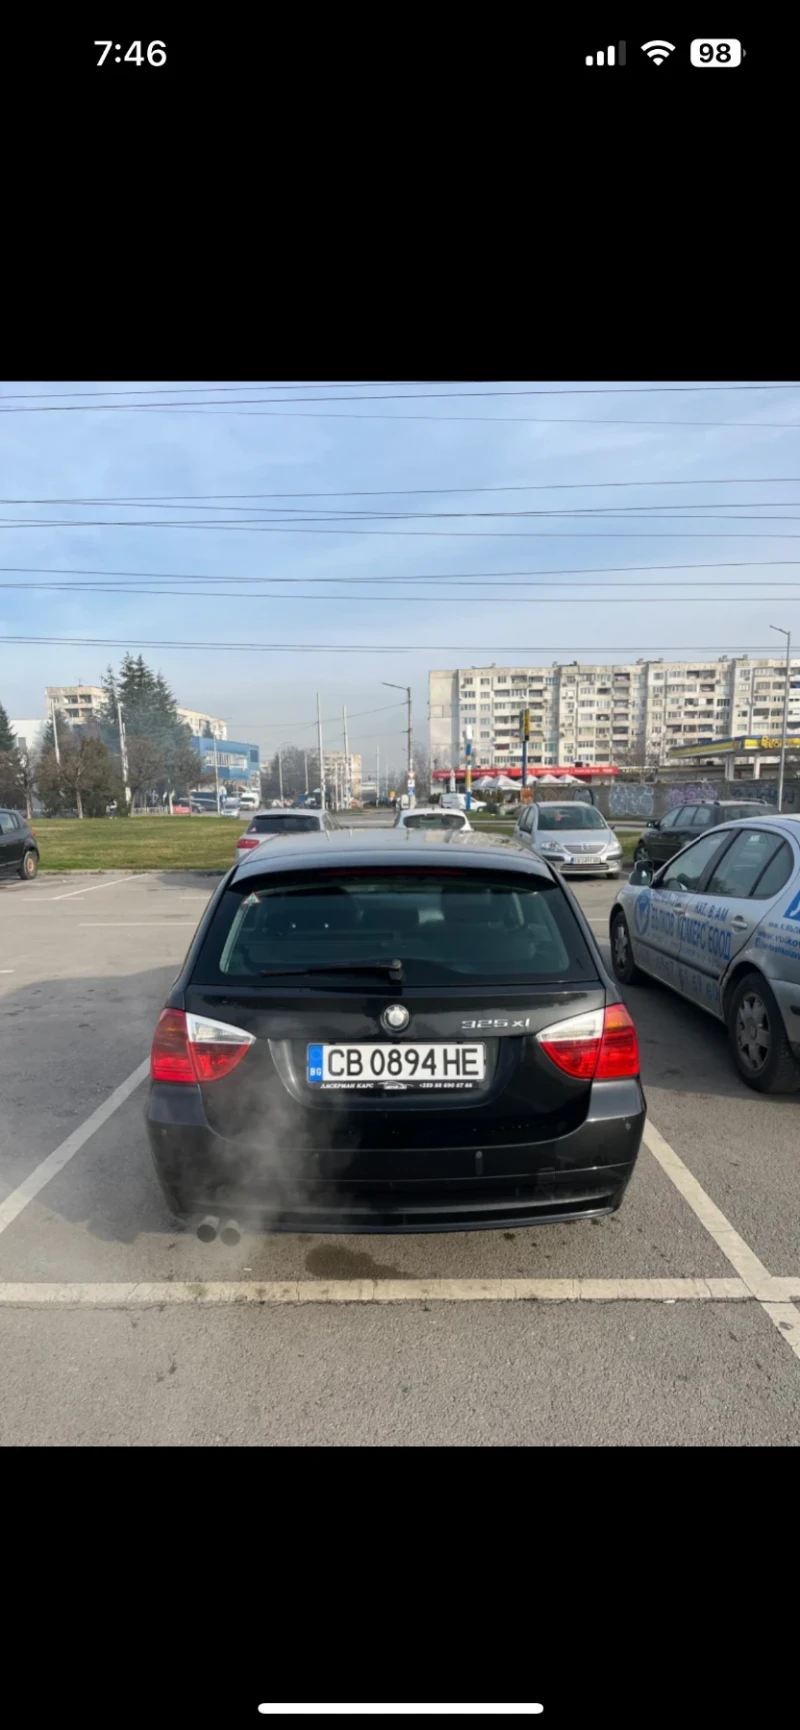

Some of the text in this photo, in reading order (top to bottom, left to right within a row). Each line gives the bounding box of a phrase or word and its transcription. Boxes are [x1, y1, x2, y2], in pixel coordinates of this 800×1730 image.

[327, 1048, 364, 1076] CB
[369, 1048, 437, 1076] 0894
[310, 1067, 322, 1077] BG
